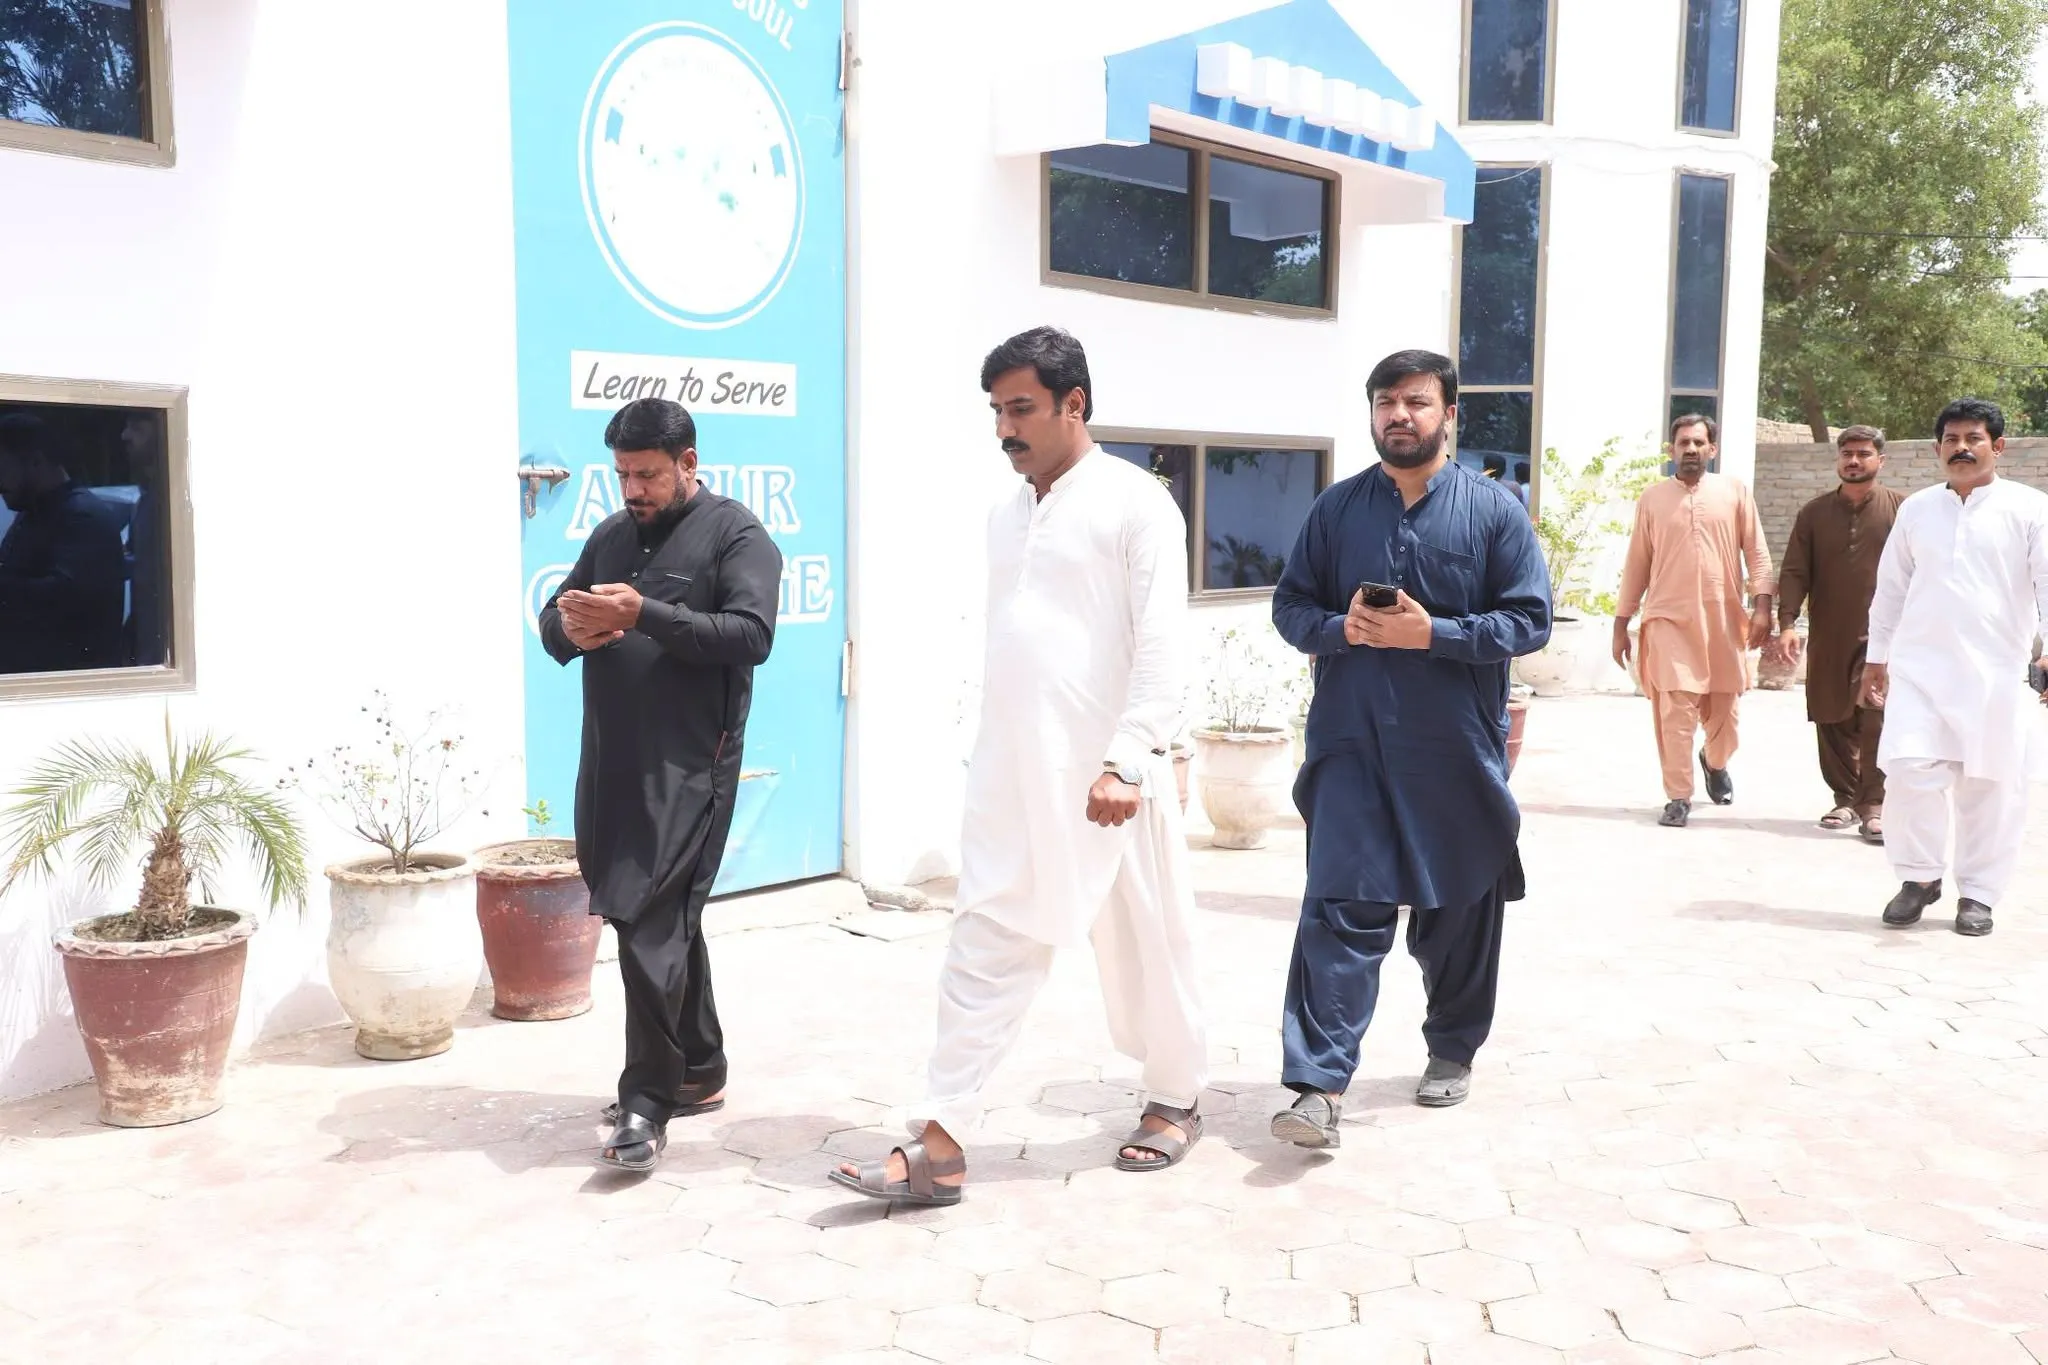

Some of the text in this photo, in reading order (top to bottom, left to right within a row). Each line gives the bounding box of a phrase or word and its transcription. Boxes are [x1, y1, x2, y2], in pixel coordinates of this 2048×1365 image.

[582, 361, 788, 407] Learn to Serve
